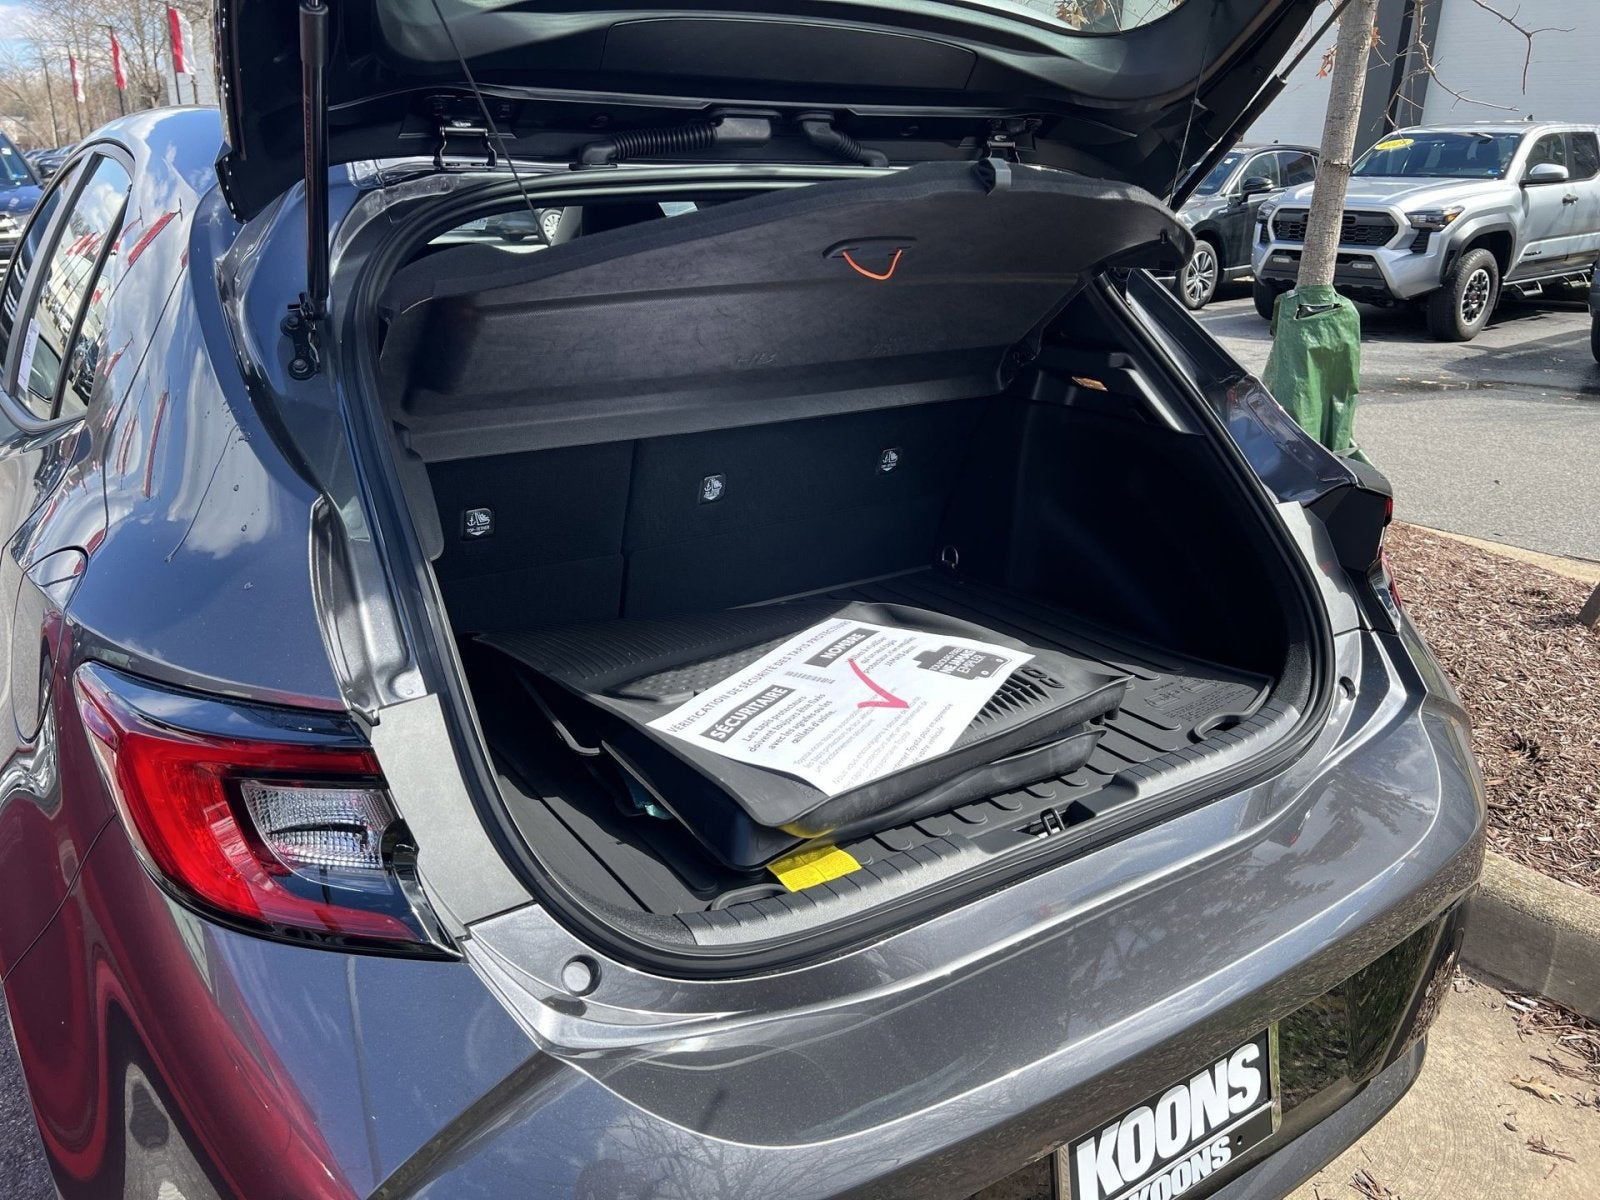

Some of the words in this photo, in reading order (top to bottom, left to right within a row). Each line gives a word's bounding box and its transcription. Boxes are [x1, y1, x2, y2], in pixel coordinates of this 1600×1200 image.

[820, 633, 866, 659] NOMBRE
[666, 694, 731, 733] VÉRIFICATION
[726, 687, 743, 696] DE
[738, 665, 778, 689] SÉCURITÉ
[773, 656, 792, 667] DES
[710, 687, 789, 740] SÉCURITAIRE
[741, 731, 758, 742] Les
[748, 730, 777, 752] doivent
[1076, 1043, 1262, 1200] KOONS
